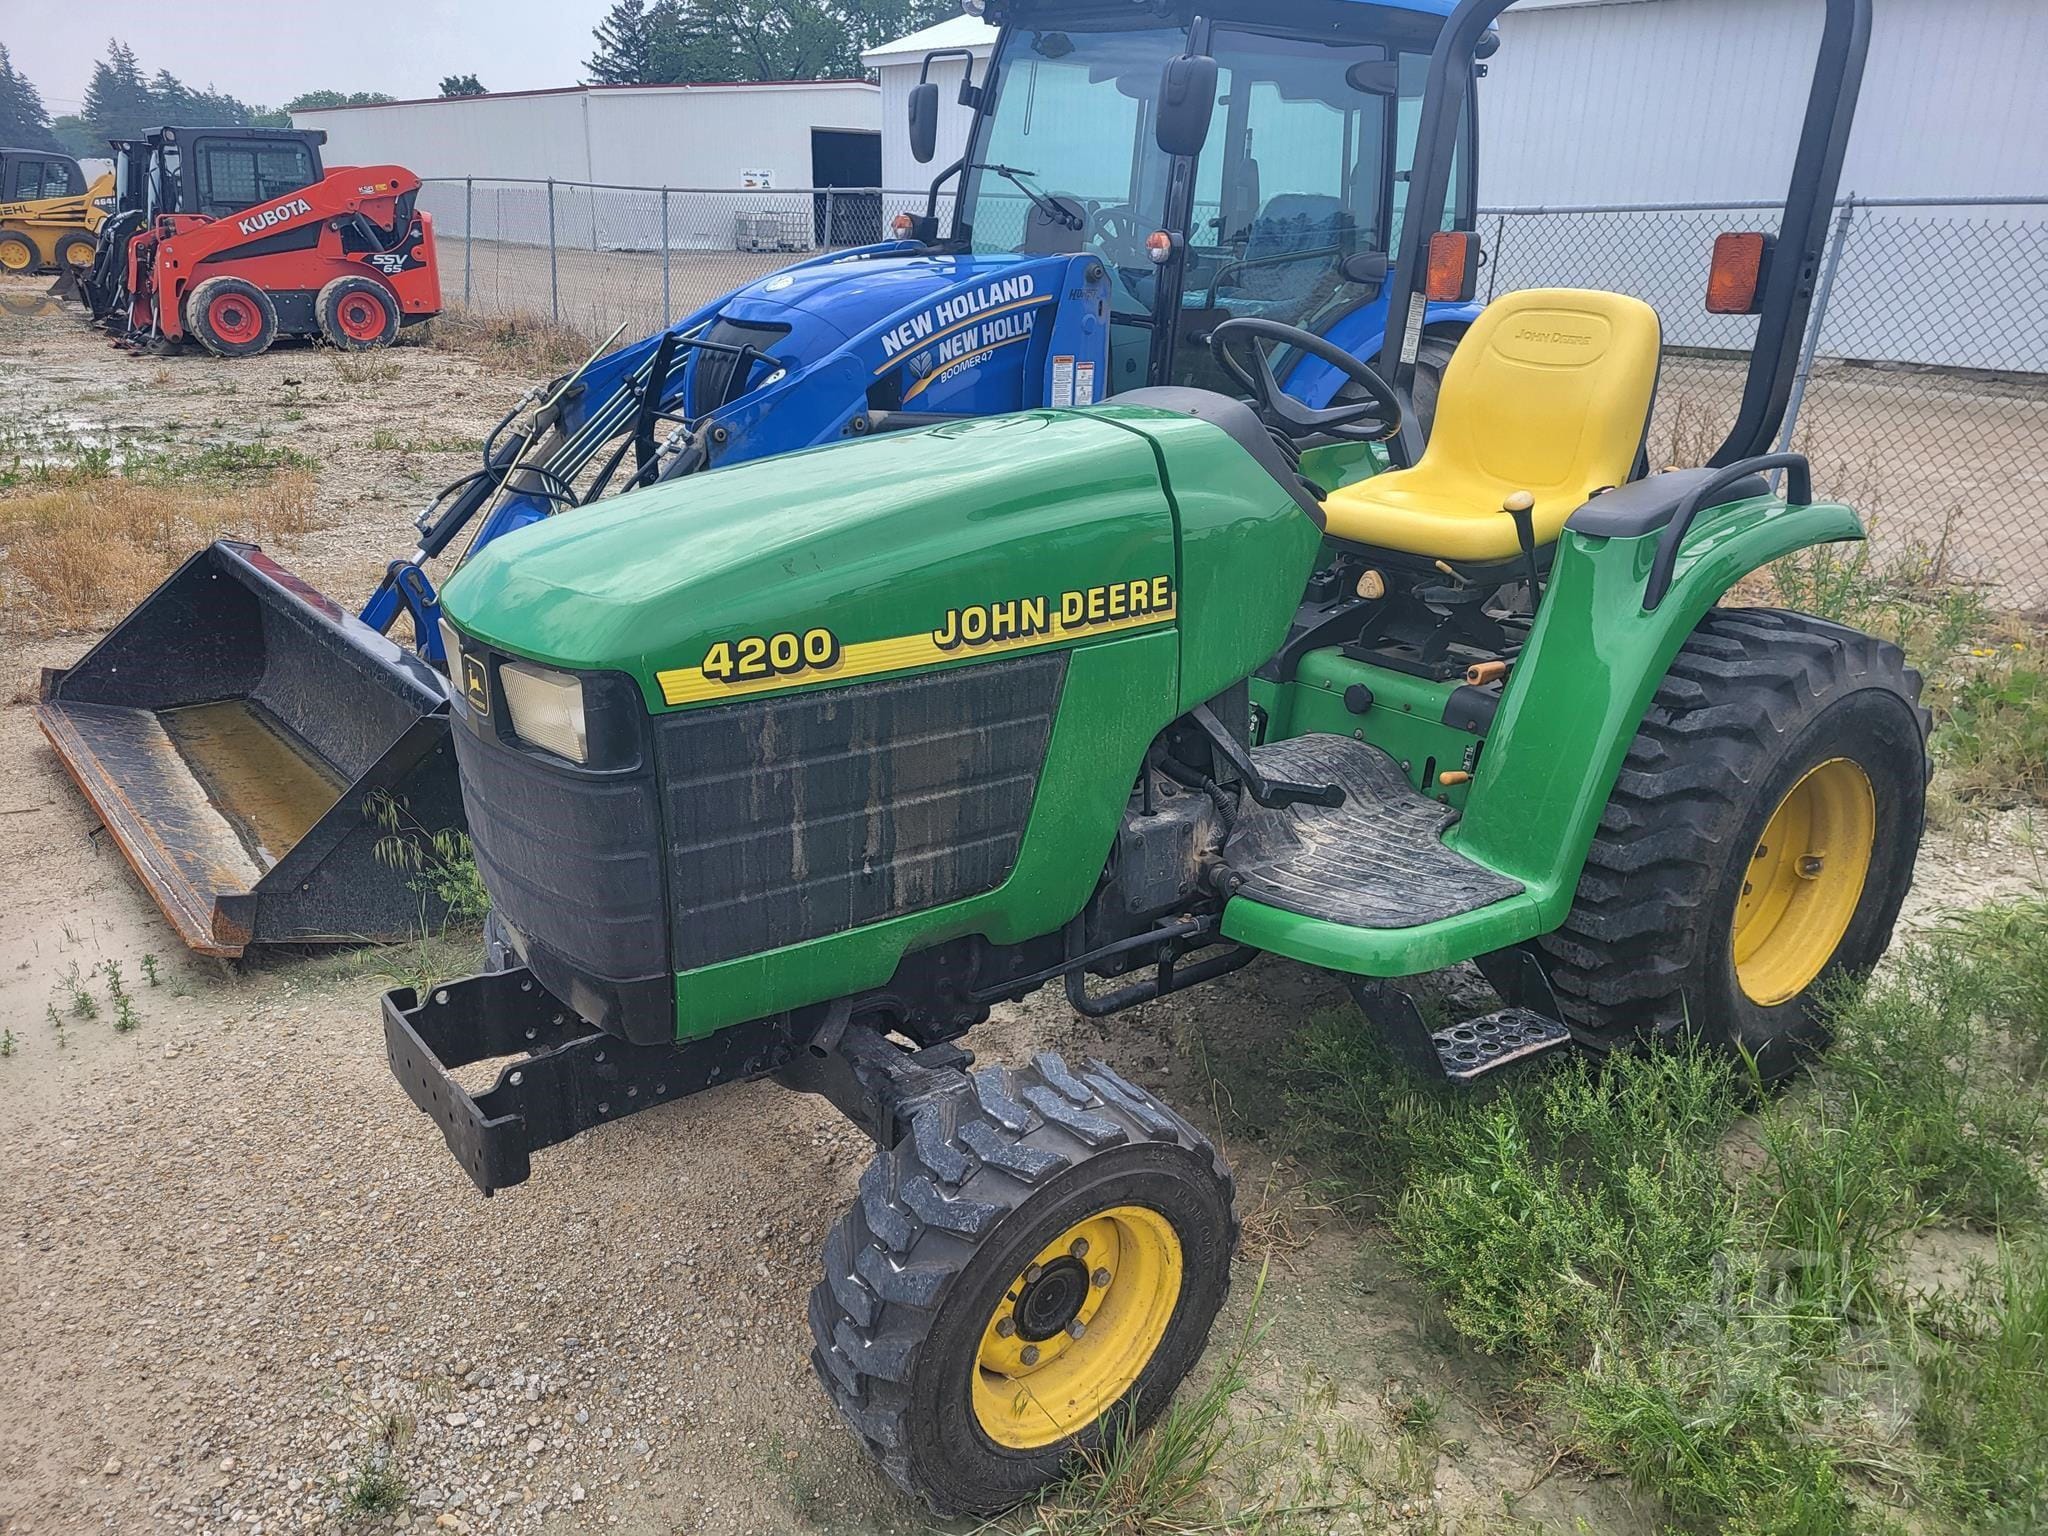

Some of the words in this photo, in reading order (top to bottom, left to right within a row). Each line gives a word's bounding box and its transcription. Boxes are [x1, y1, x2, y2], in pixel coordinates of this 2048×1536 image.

[0, 204, 33, 216] EHL
[238, 198, 312, 235] KUBOTA
[372, 254, 408, 264] SSV
[383, 264, 402, 273] 65
[881, 310, 933, 357] NEW
[935, 274, 1034, 327] HOLLAND
[939, 326, 979, 364] NEW
[1514, 328, 1550, 343] JOHN
[1550, 331, 1593, 346] DEERE
[932, 596, 1050, 652] JOHN
[1059, 574, 1175, 628] DEERE
[702, 628, 841, 683] 4200
